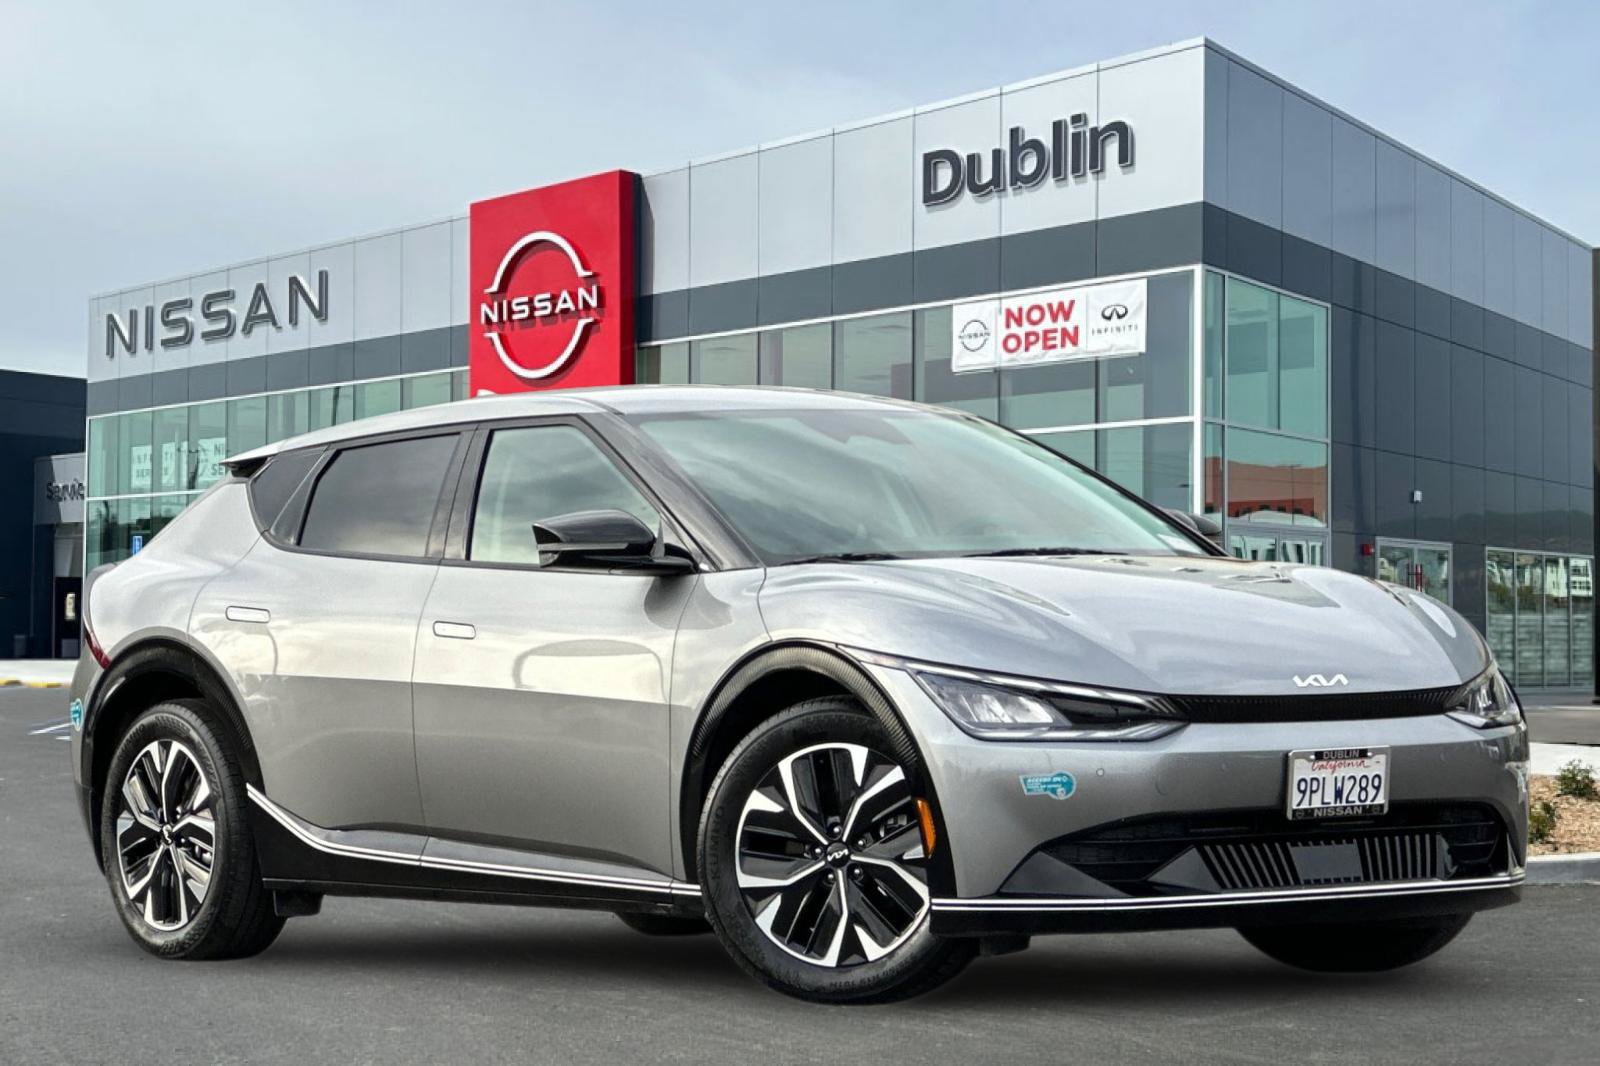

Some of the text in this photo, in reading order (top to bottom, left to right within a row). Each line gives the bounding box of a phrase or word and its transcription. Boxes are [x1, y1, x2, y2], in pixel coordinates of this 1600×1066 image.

[922, 112, 1135, 208] Dublin
[105, 269, 329, 359] NISSAN
[480, 284, 599, 325] NISSAN
[1004, 299, 1076, 329] NOW
[1002, 325, 1080, 354] OPEN
[1091, 324, 1139, 337] INFINITI
[46, 477, 85, 502] Servic
[1292, 673, 1349, 687] KIA
[1311, 758, 1371, 775] California
[1323, 749, 1360, 760] DUBLIN
[1296, 774, 1382, 808] 9PLW289
[1313, 806, 1362, 817] NISSAN
